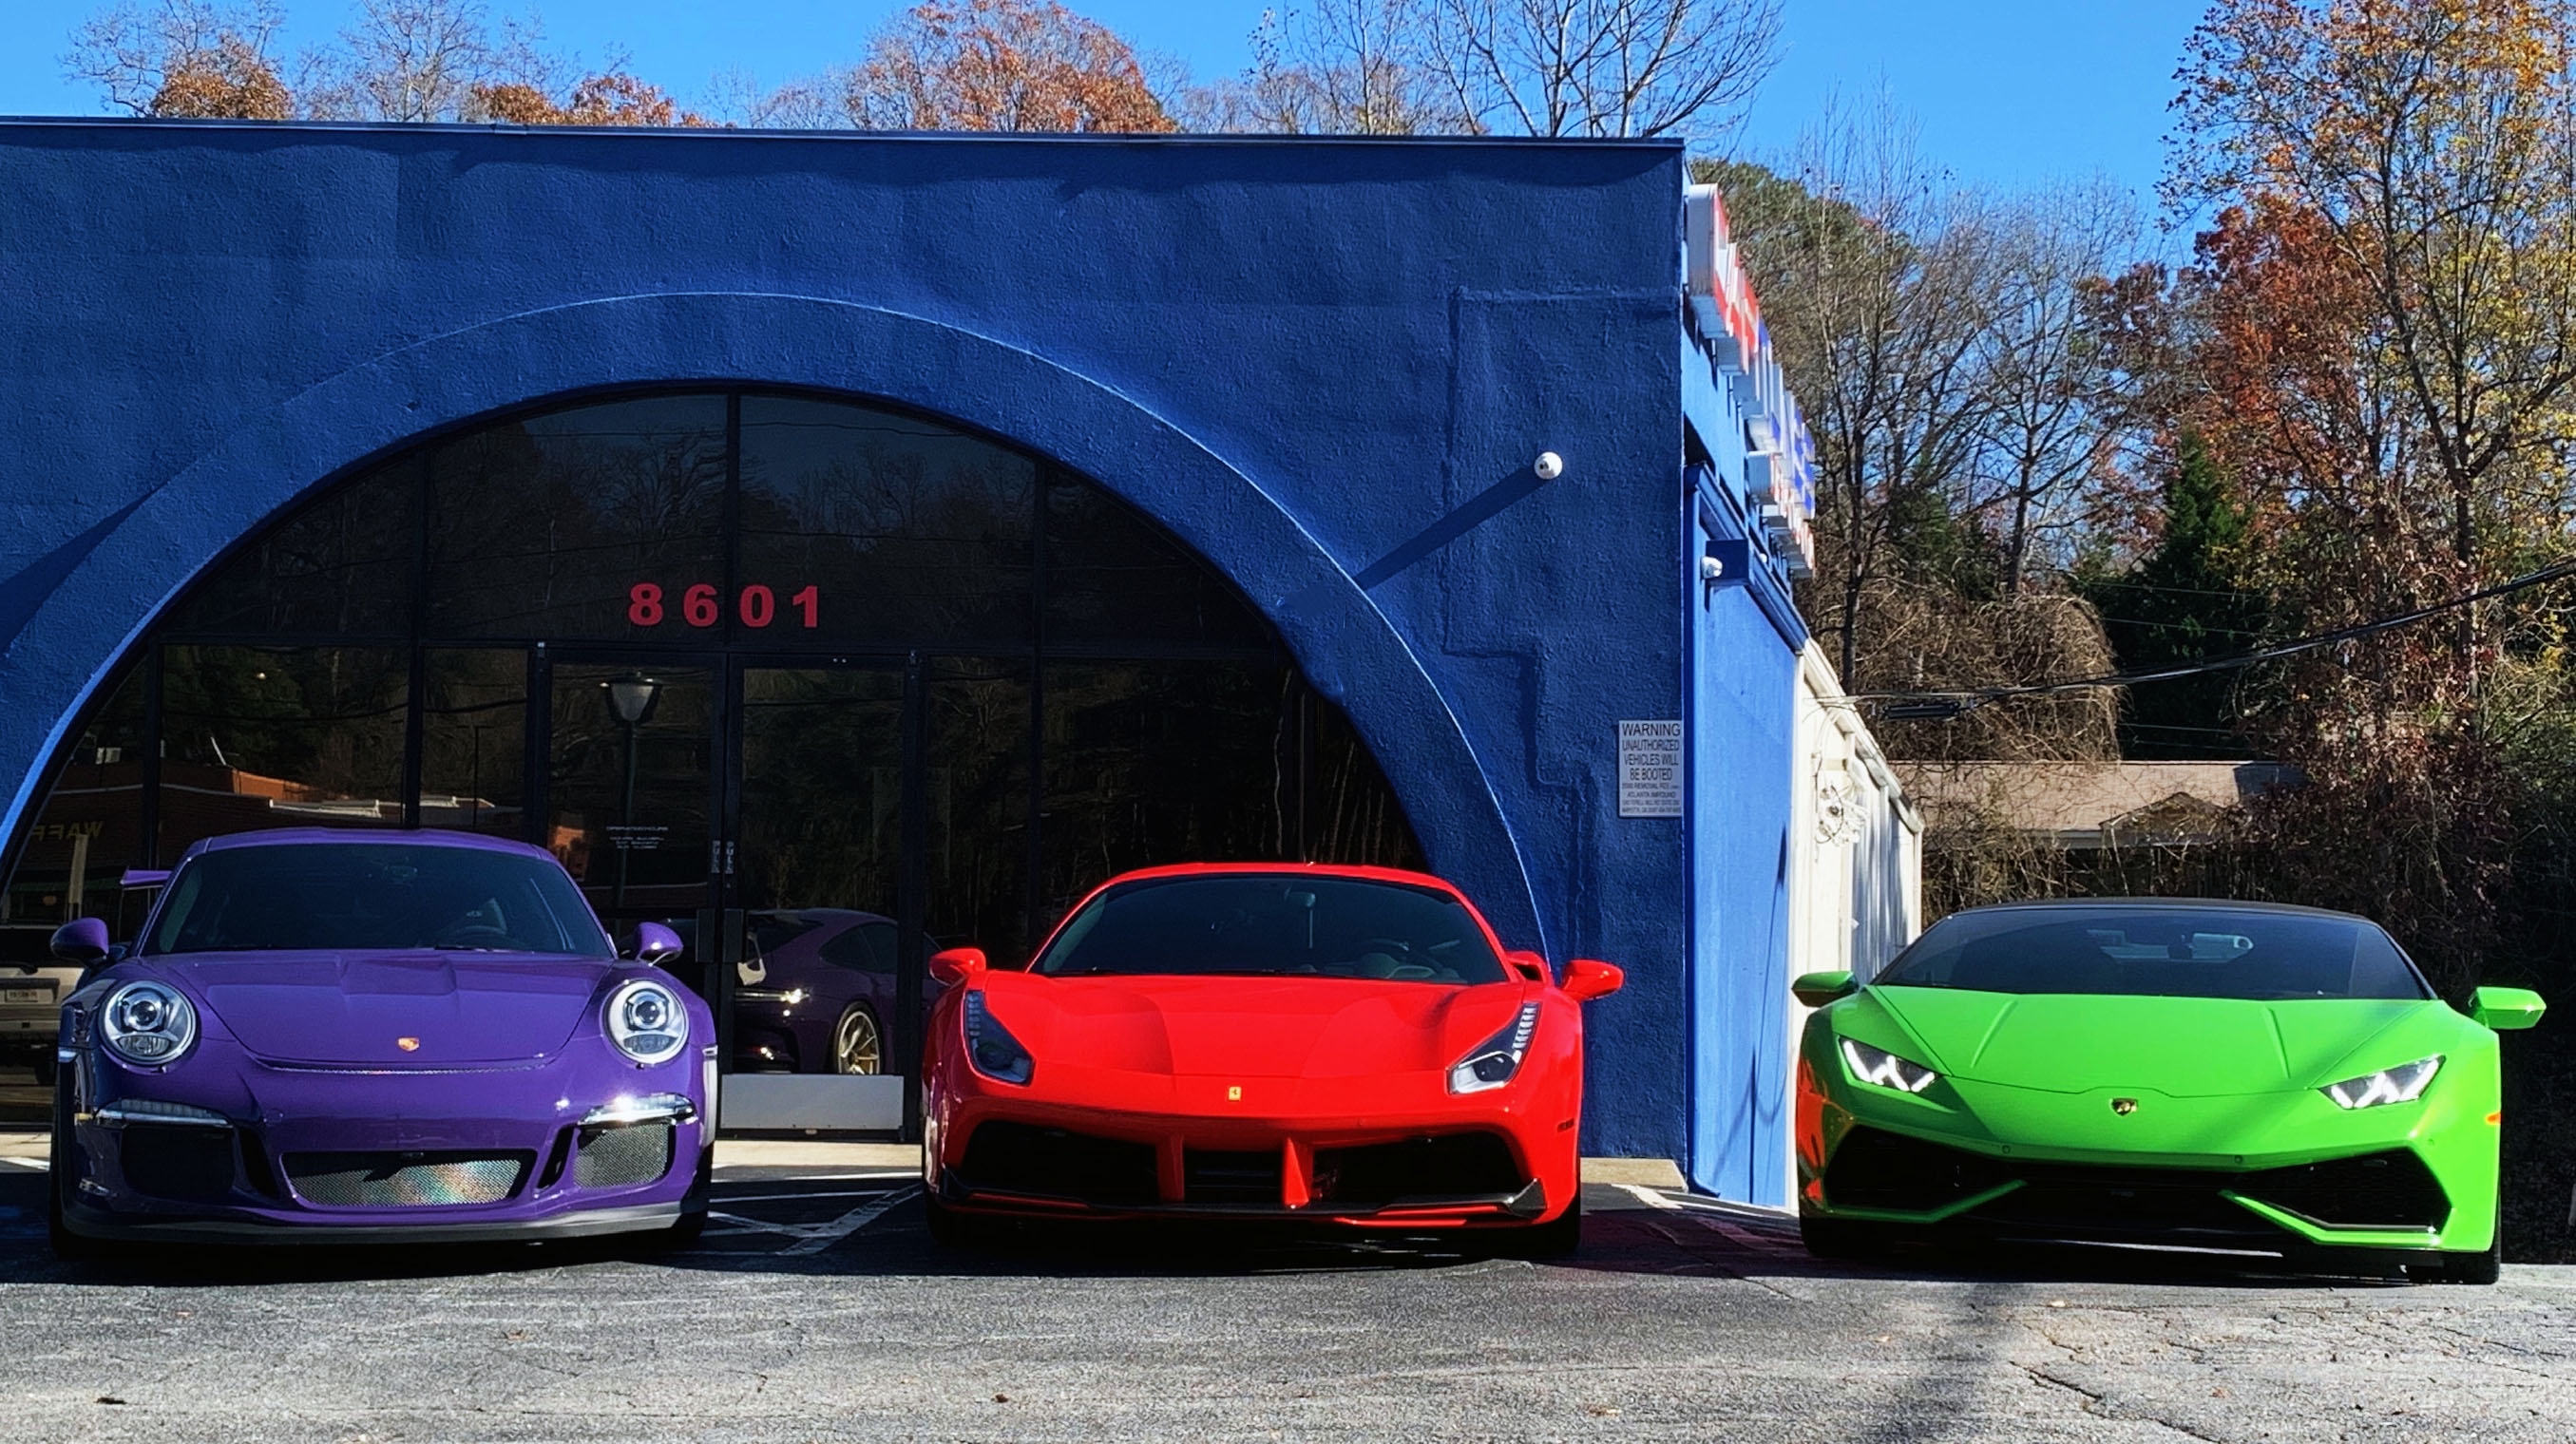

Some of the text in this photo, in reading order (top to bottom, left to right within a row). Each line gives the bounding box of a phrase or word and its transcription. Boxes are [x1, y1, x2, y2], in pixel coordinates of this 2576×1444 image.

[627, 582, 819, 628] 8601
[1621, 723, 1681, 736] WARNING
[1621, 739, 1680, 751] UNAUTHORIZED
[1624, 753, 1679, 766] VEHICLES WILL
[1630, 768, 1672, 781] BE BOOTED
